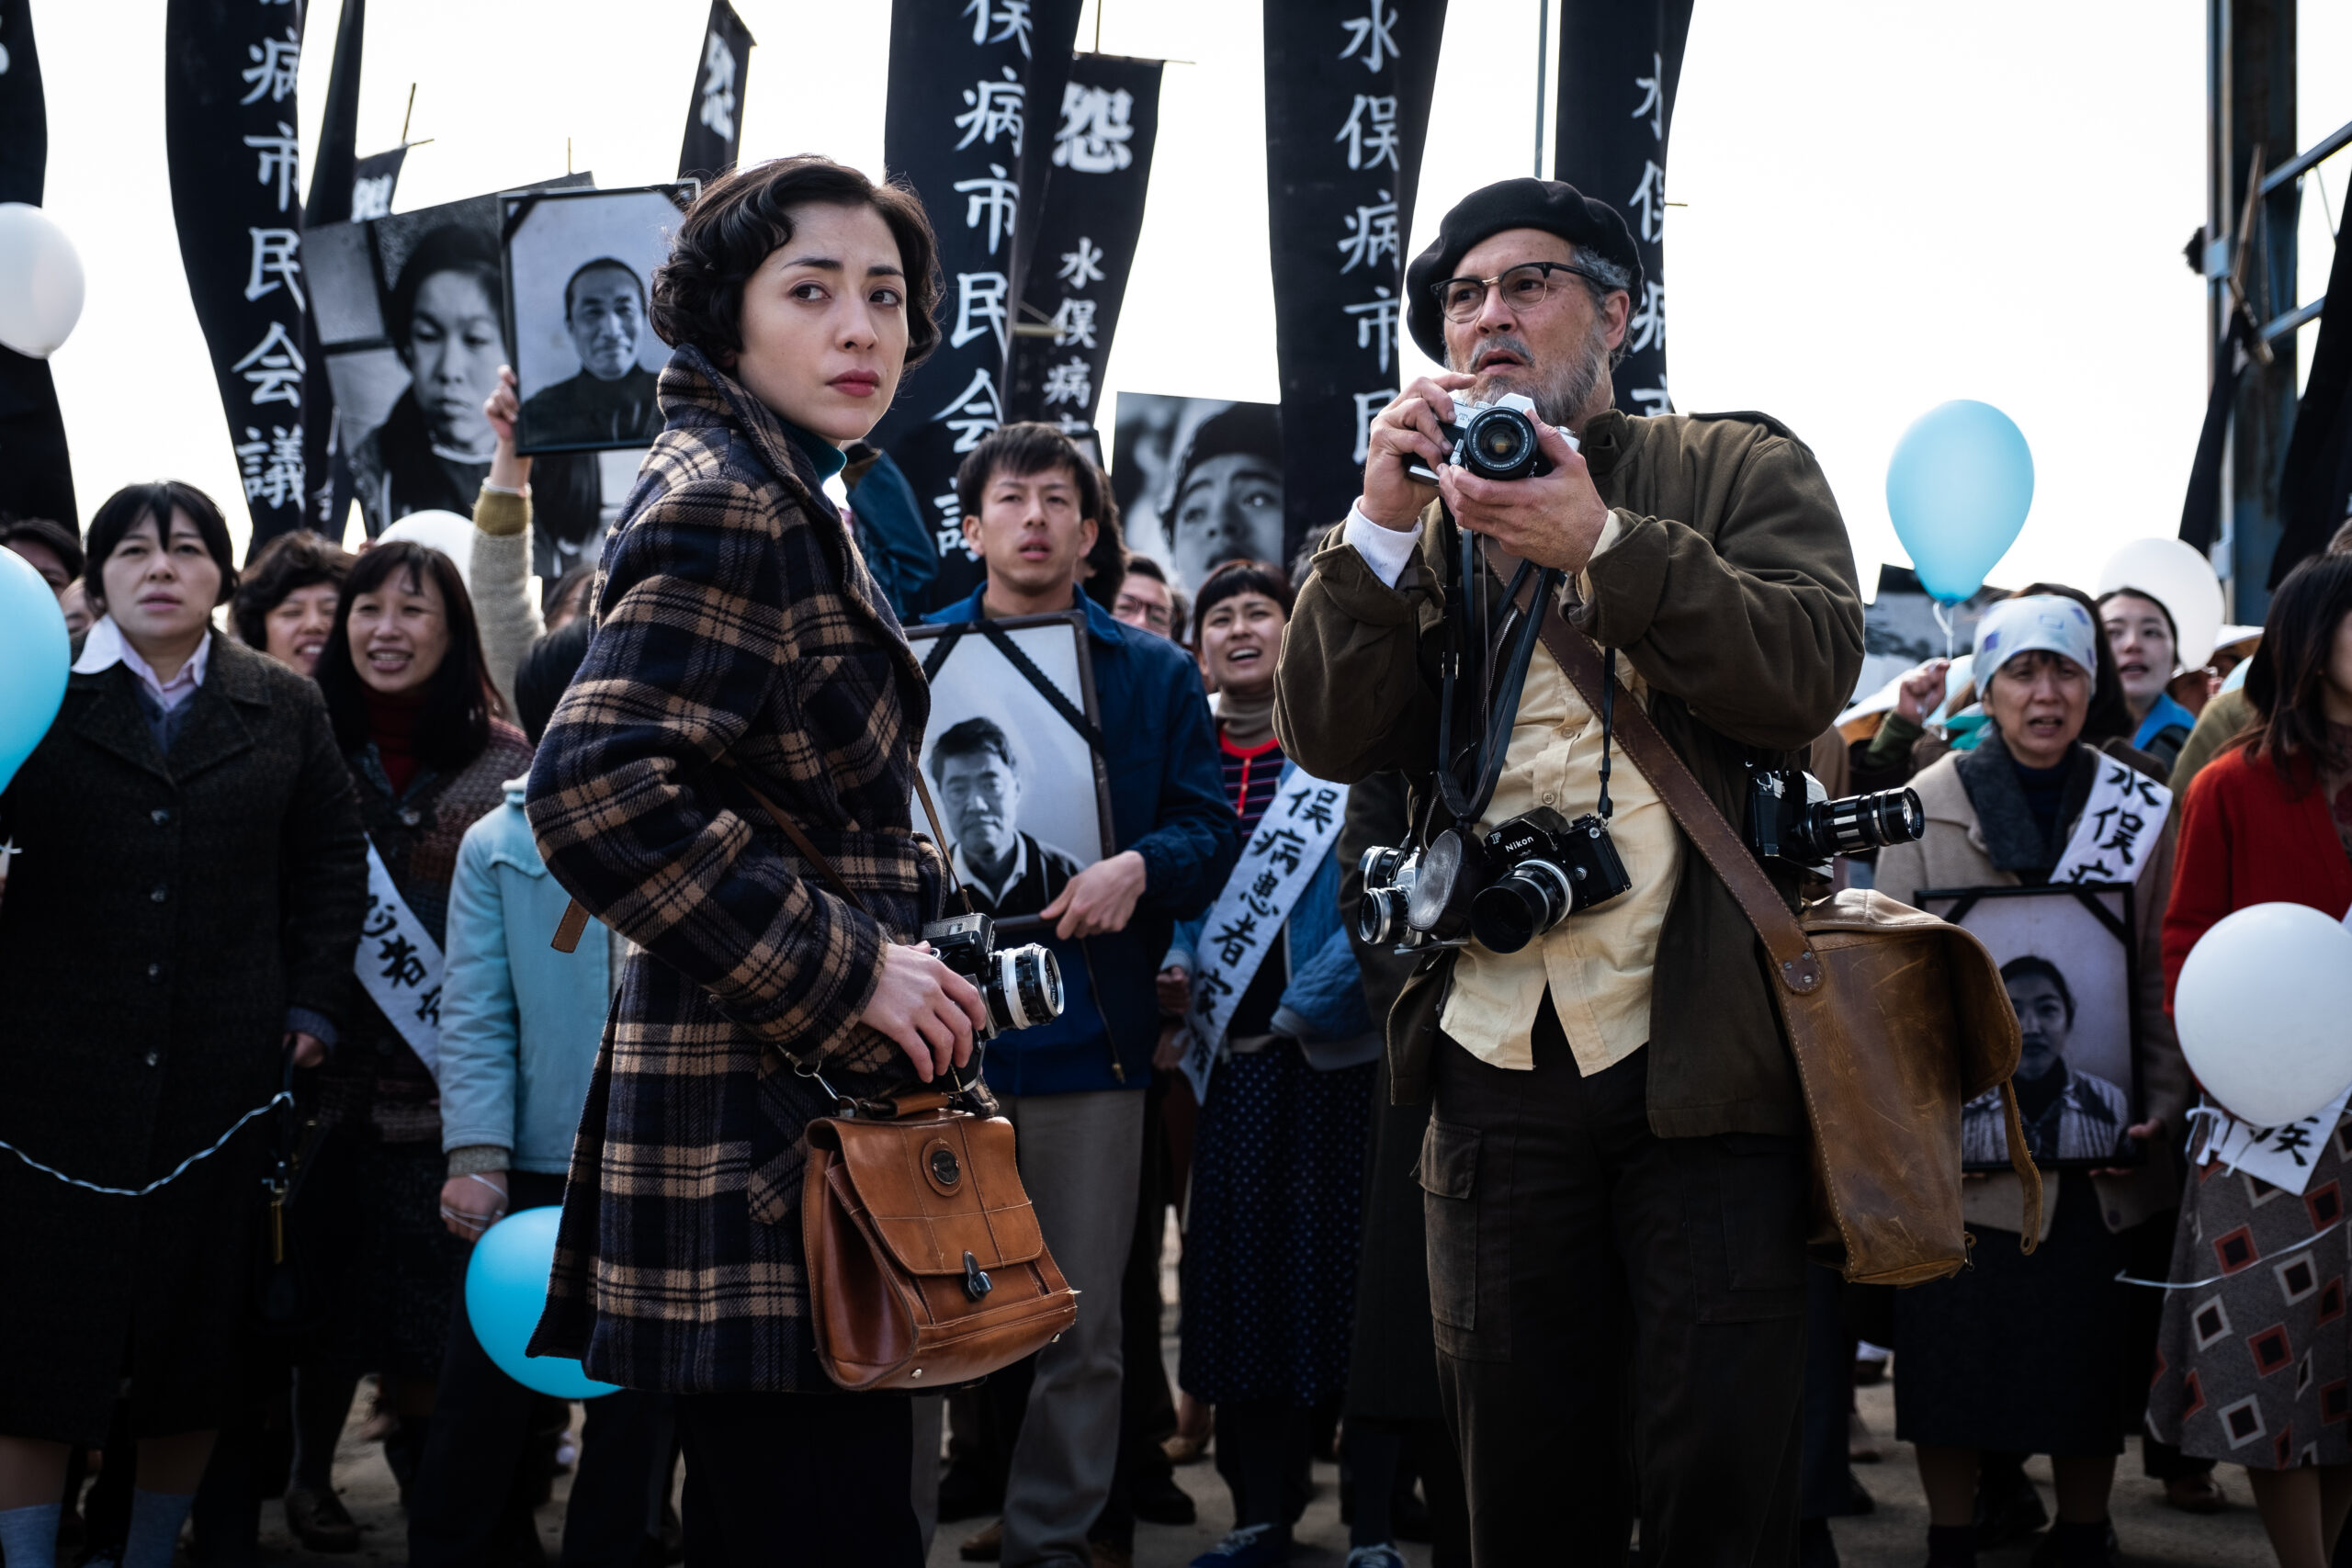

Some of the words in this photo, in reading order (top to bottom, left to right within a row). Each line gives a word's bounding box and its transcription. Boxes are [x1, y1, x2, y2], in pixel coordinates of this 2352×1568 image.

[1052, 81, 1135, 174] 怨
[232, 0, 306, 513] 病市民会議
[1505, 836, 1534, 852] Nikon
